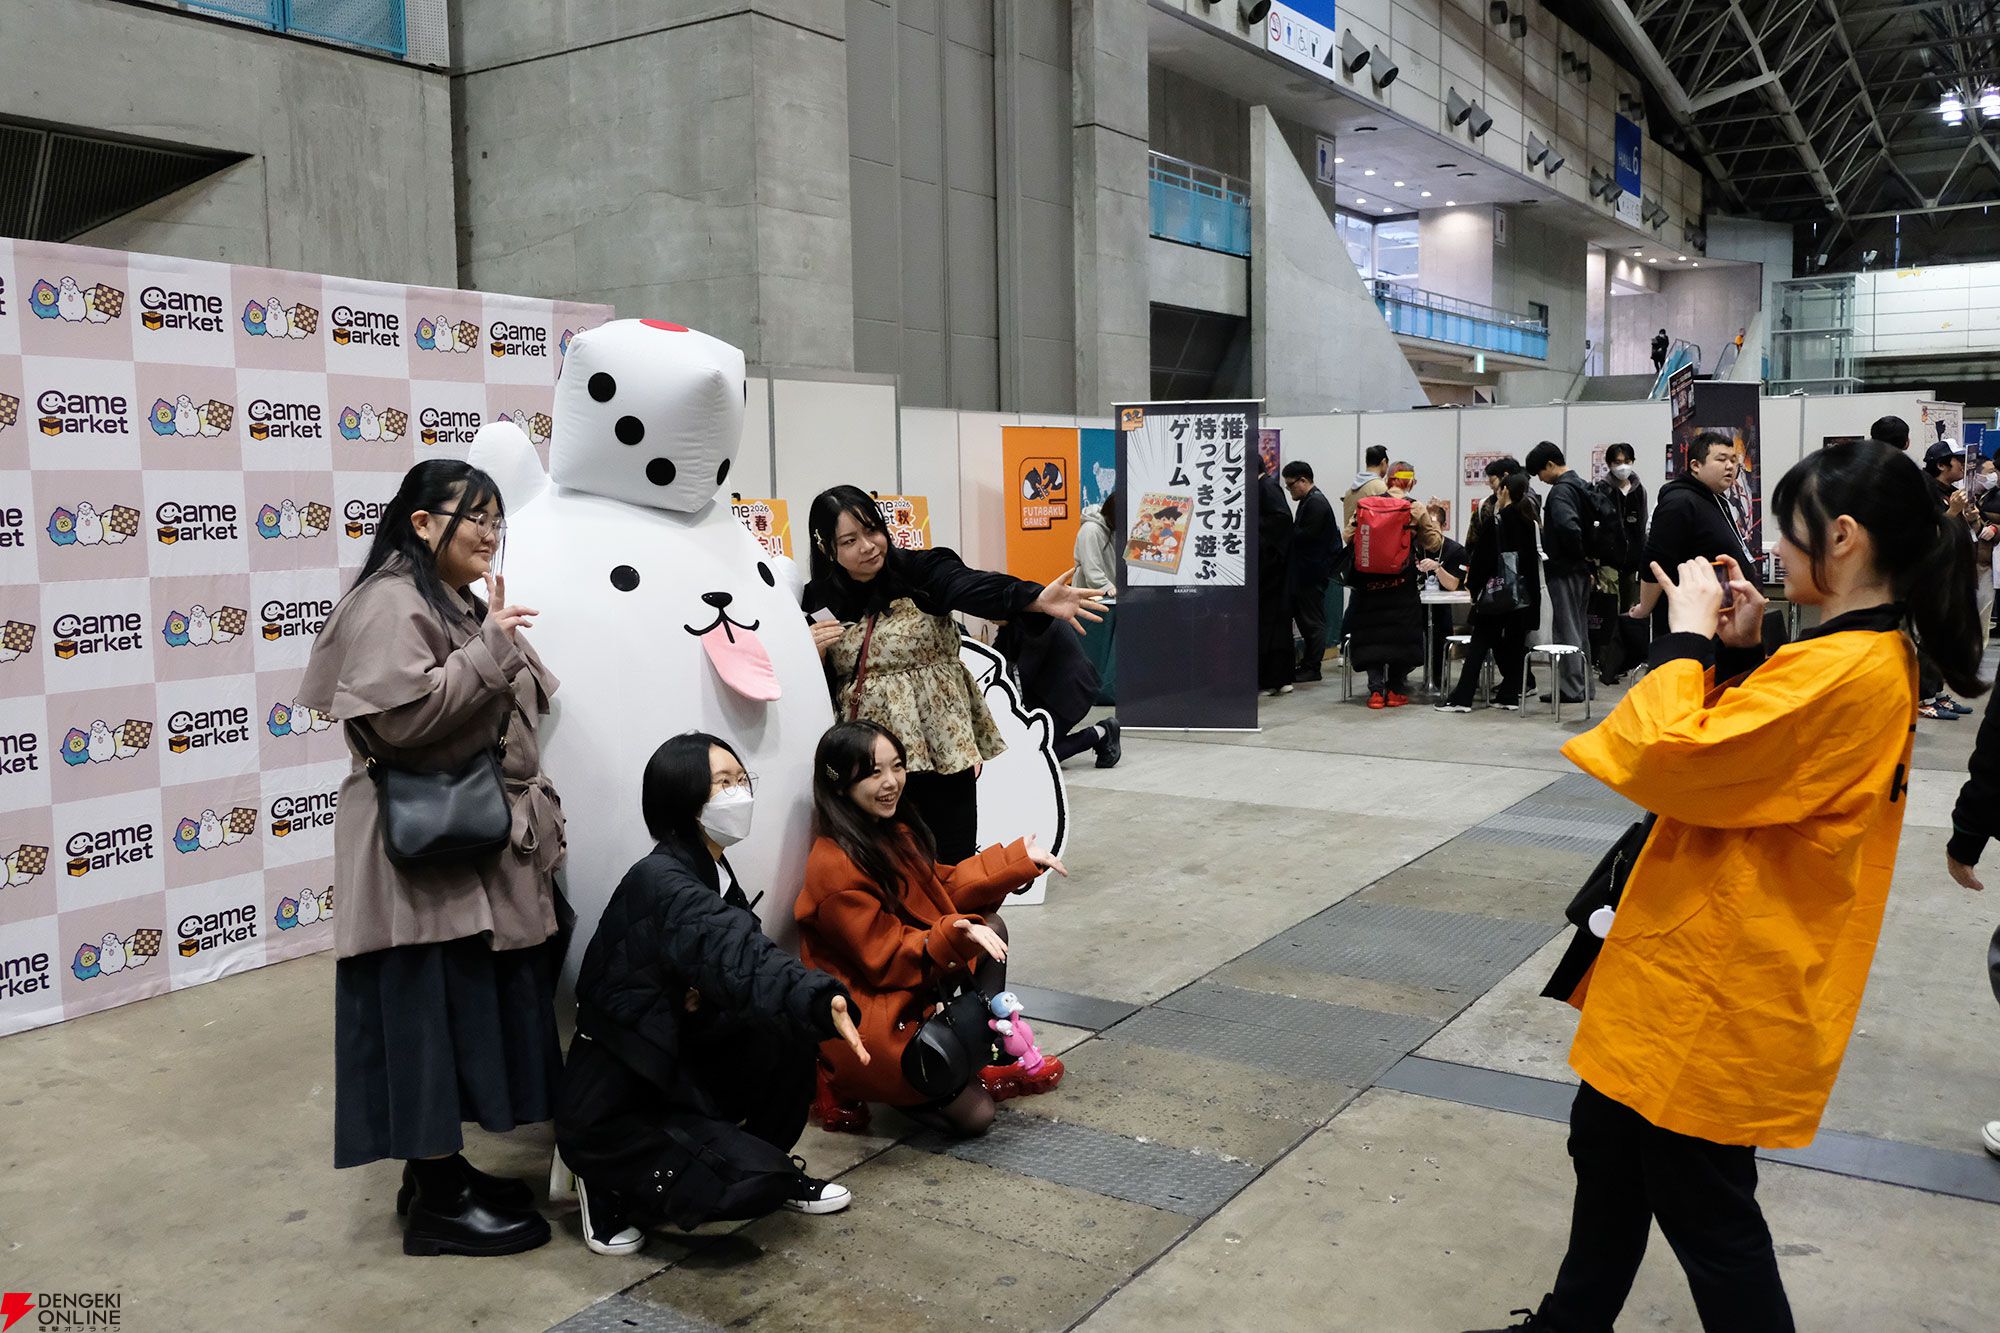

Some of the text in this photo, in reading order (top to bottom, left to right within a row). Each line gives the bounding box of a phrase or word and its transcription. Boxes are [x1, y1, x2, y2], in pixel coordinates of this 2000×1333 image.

[1633, 145, 1639, 176] 6
[140, 287, 223, 315] Game
[332, 306, 400, 330] Game
[490, 322, 546, 342] Game
[37, 391, 127, 415] Game
[248, 400, 321, 421] Game
[420, 408, 481, 428] Game
[1169, 417, 1190, 487] ゲーム
[1221, 417, 1244, 555] 推しマンガを
[750, 505, 769, 513] 2026
[1195, 417, 1217, 580] 持ってきて遊ぶ
[156, 502, 236, 525] Game
[755, 515, 768, 531] 春
[897, 510, 910, 525] 秋
[1023, 506, 1064, 517] FUTABAKU
[1023, 517, 1048, 527] GAMES
[261, 600, 333, 622] Game
[53, 613, 142, 638] Game
[168, 706, 249, 734] Game
[271, 791, 338, 819] Game
[65, 823, 153, 857] Game
[178, 905, 257, 938] Game
